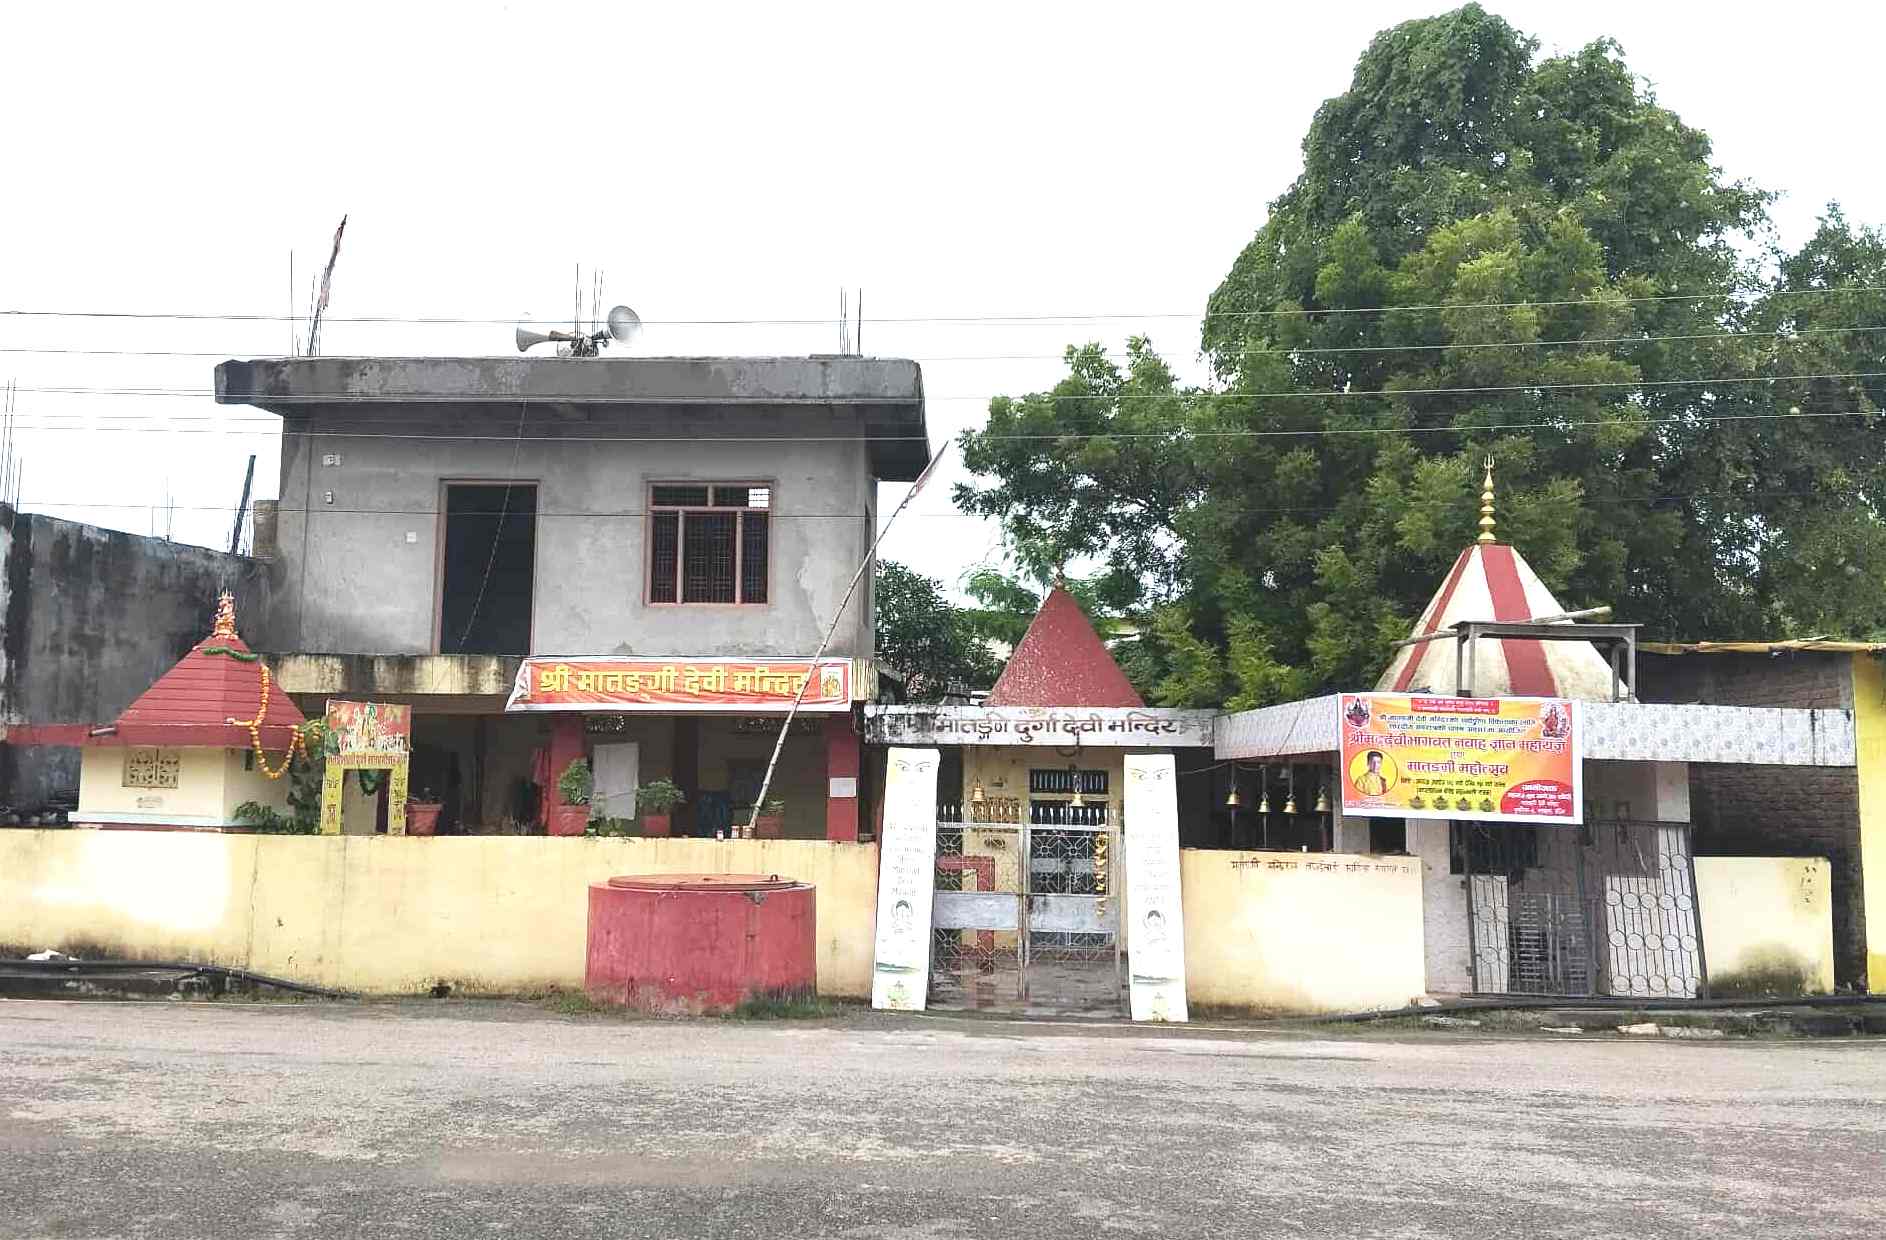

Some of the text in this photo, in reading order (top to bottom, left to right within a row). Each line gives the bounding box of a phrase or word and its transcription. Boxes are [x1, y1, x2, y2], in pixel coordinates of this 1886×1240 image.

[539, 665, 572, 693] श्री
[684, 665, 729, 697] देवी
[1014, 710, 1057, 742] दुर्गा
[1062, 711, 1102, 736] देवी
[1107, 710, 1177, 736] मन्दिर
